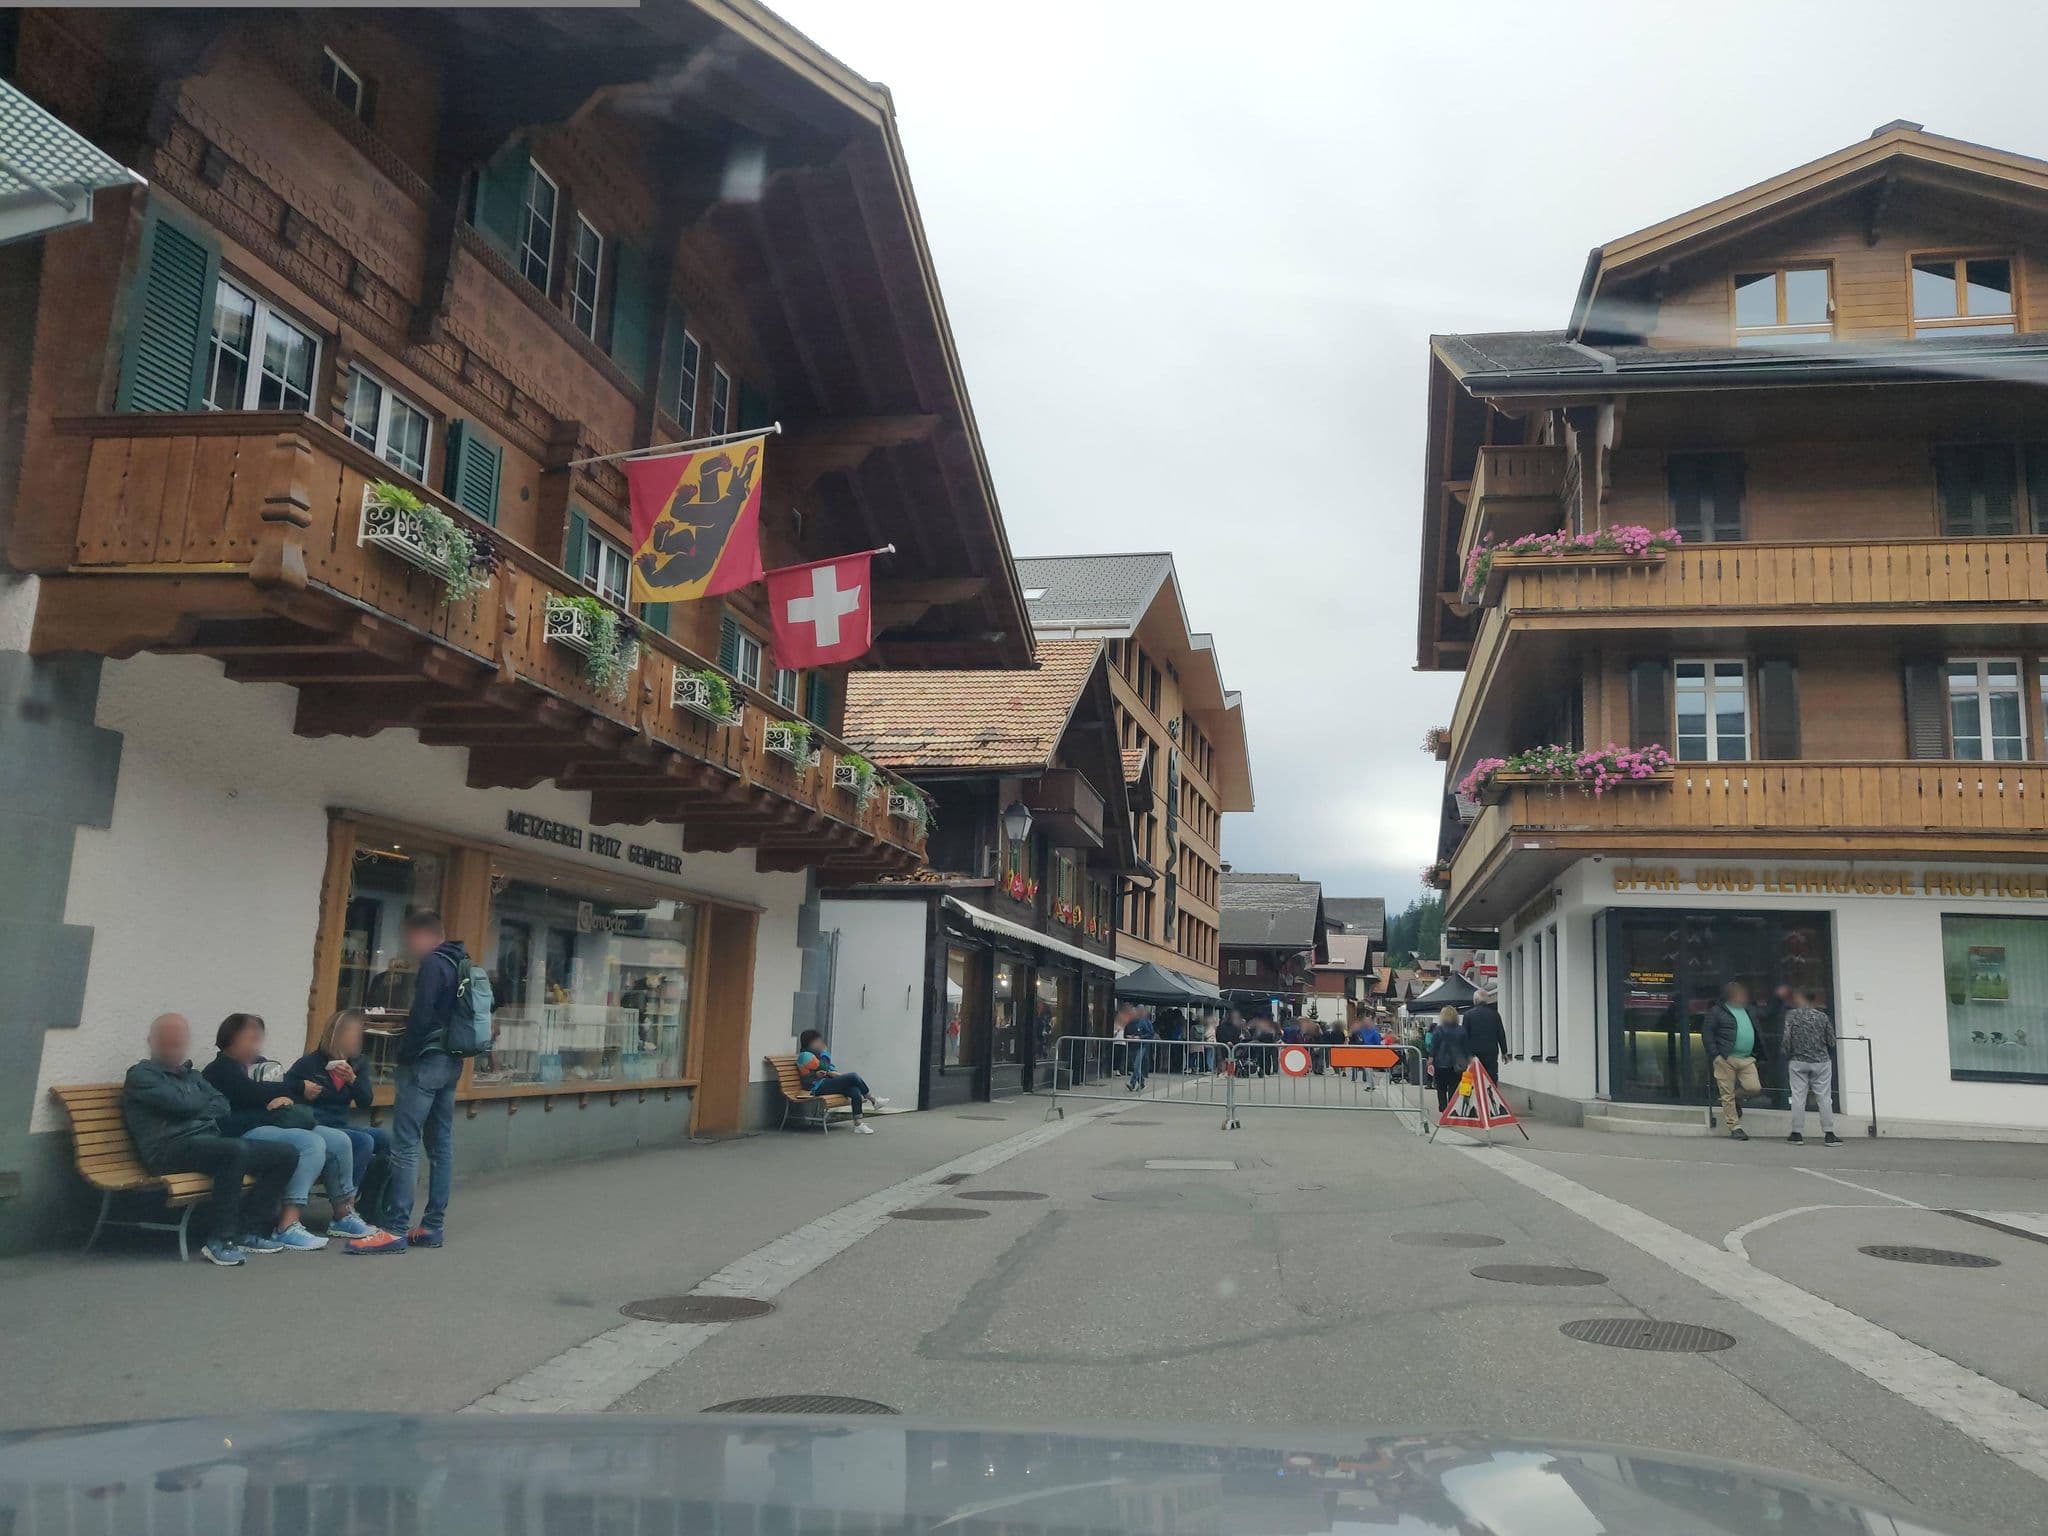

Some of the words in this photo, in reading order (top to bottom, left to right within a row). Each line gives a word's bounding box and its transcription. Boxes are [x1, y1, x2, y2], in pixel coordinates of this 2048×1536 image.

[506, 810, 582, 849] METZGEREI
[589, 832, 622, 859] FRITZ
[1696, 867, 1755, 892] UND
[1764, 868, 1916, 896] LEIHKASSE
[1924, 871, 2048, 898] FRUTIGE
